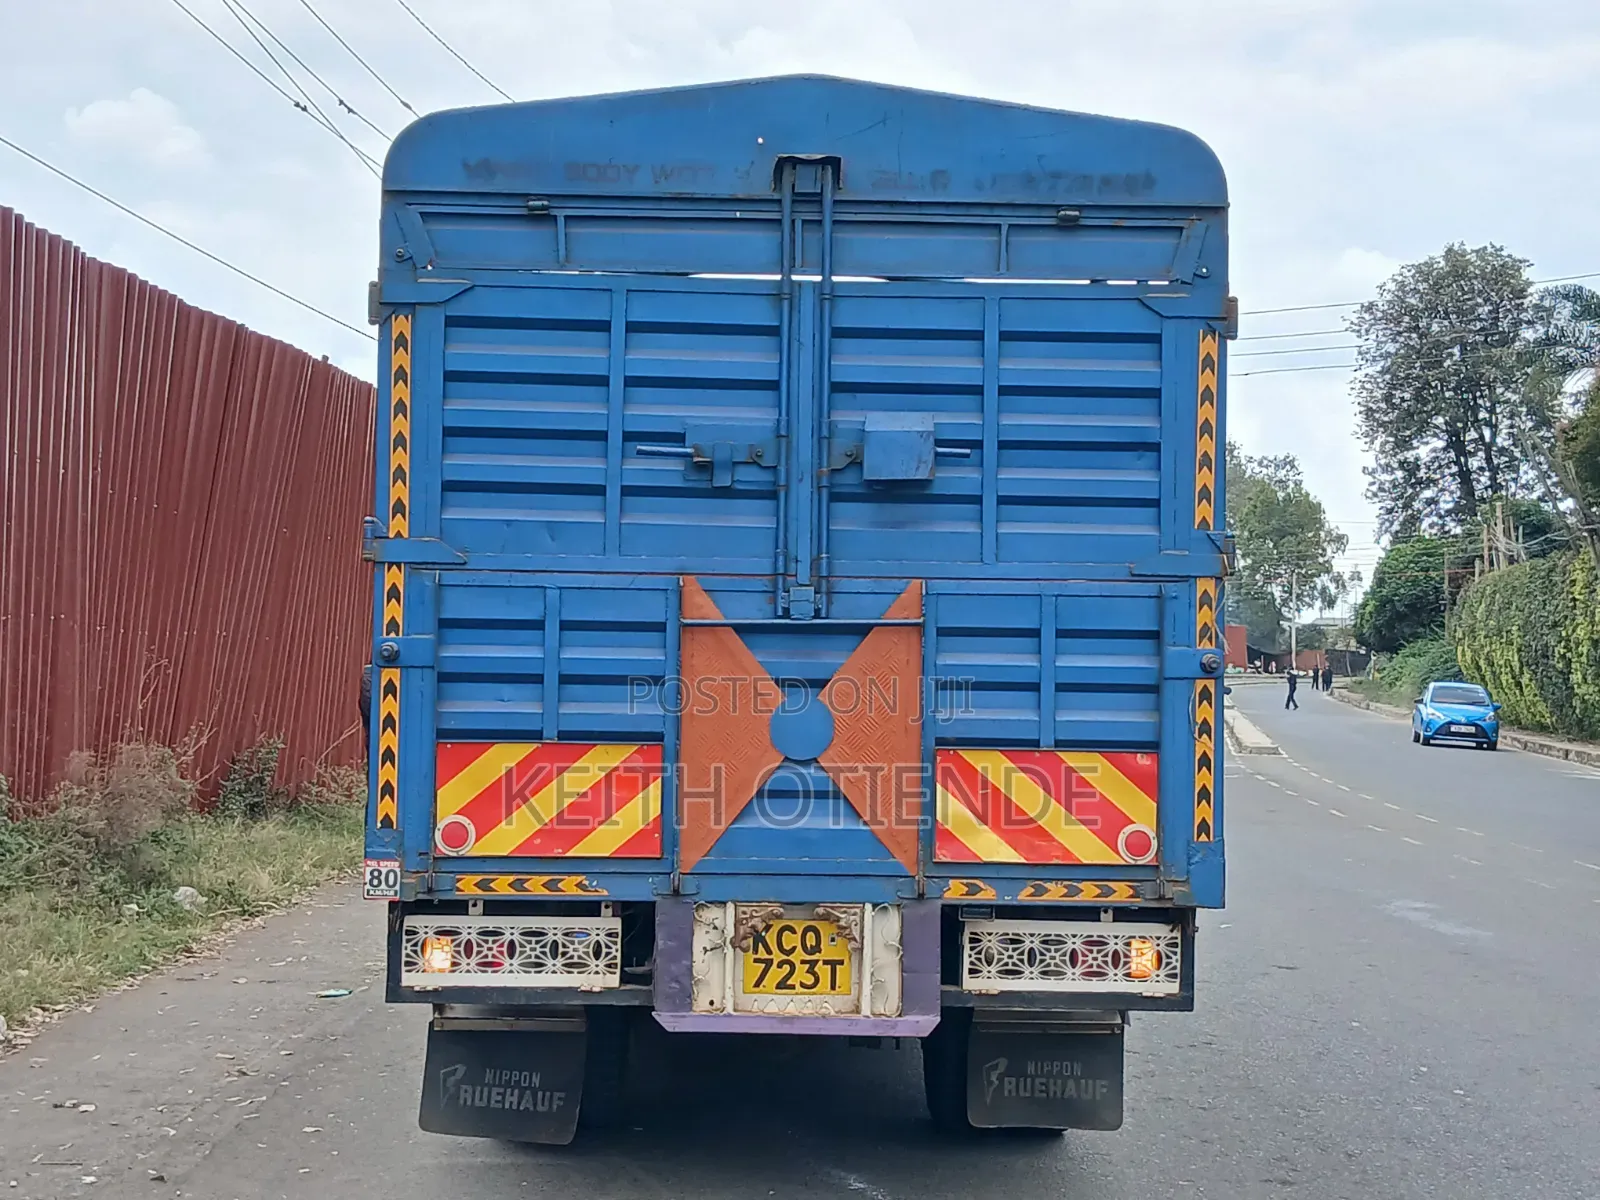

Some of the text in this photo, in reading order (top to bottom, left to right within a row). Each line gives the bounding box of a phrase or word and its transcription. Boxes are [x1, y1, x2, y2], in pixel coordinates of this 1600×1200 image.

[368, 868, 398, 889] 80
[752, 922, 822, 957] KCQ
[752, 958, 845, 991] 723T
[484, 1067, 541, 1088] NIPPON
[1027, 1060, 1082, 1076] NIPPON
